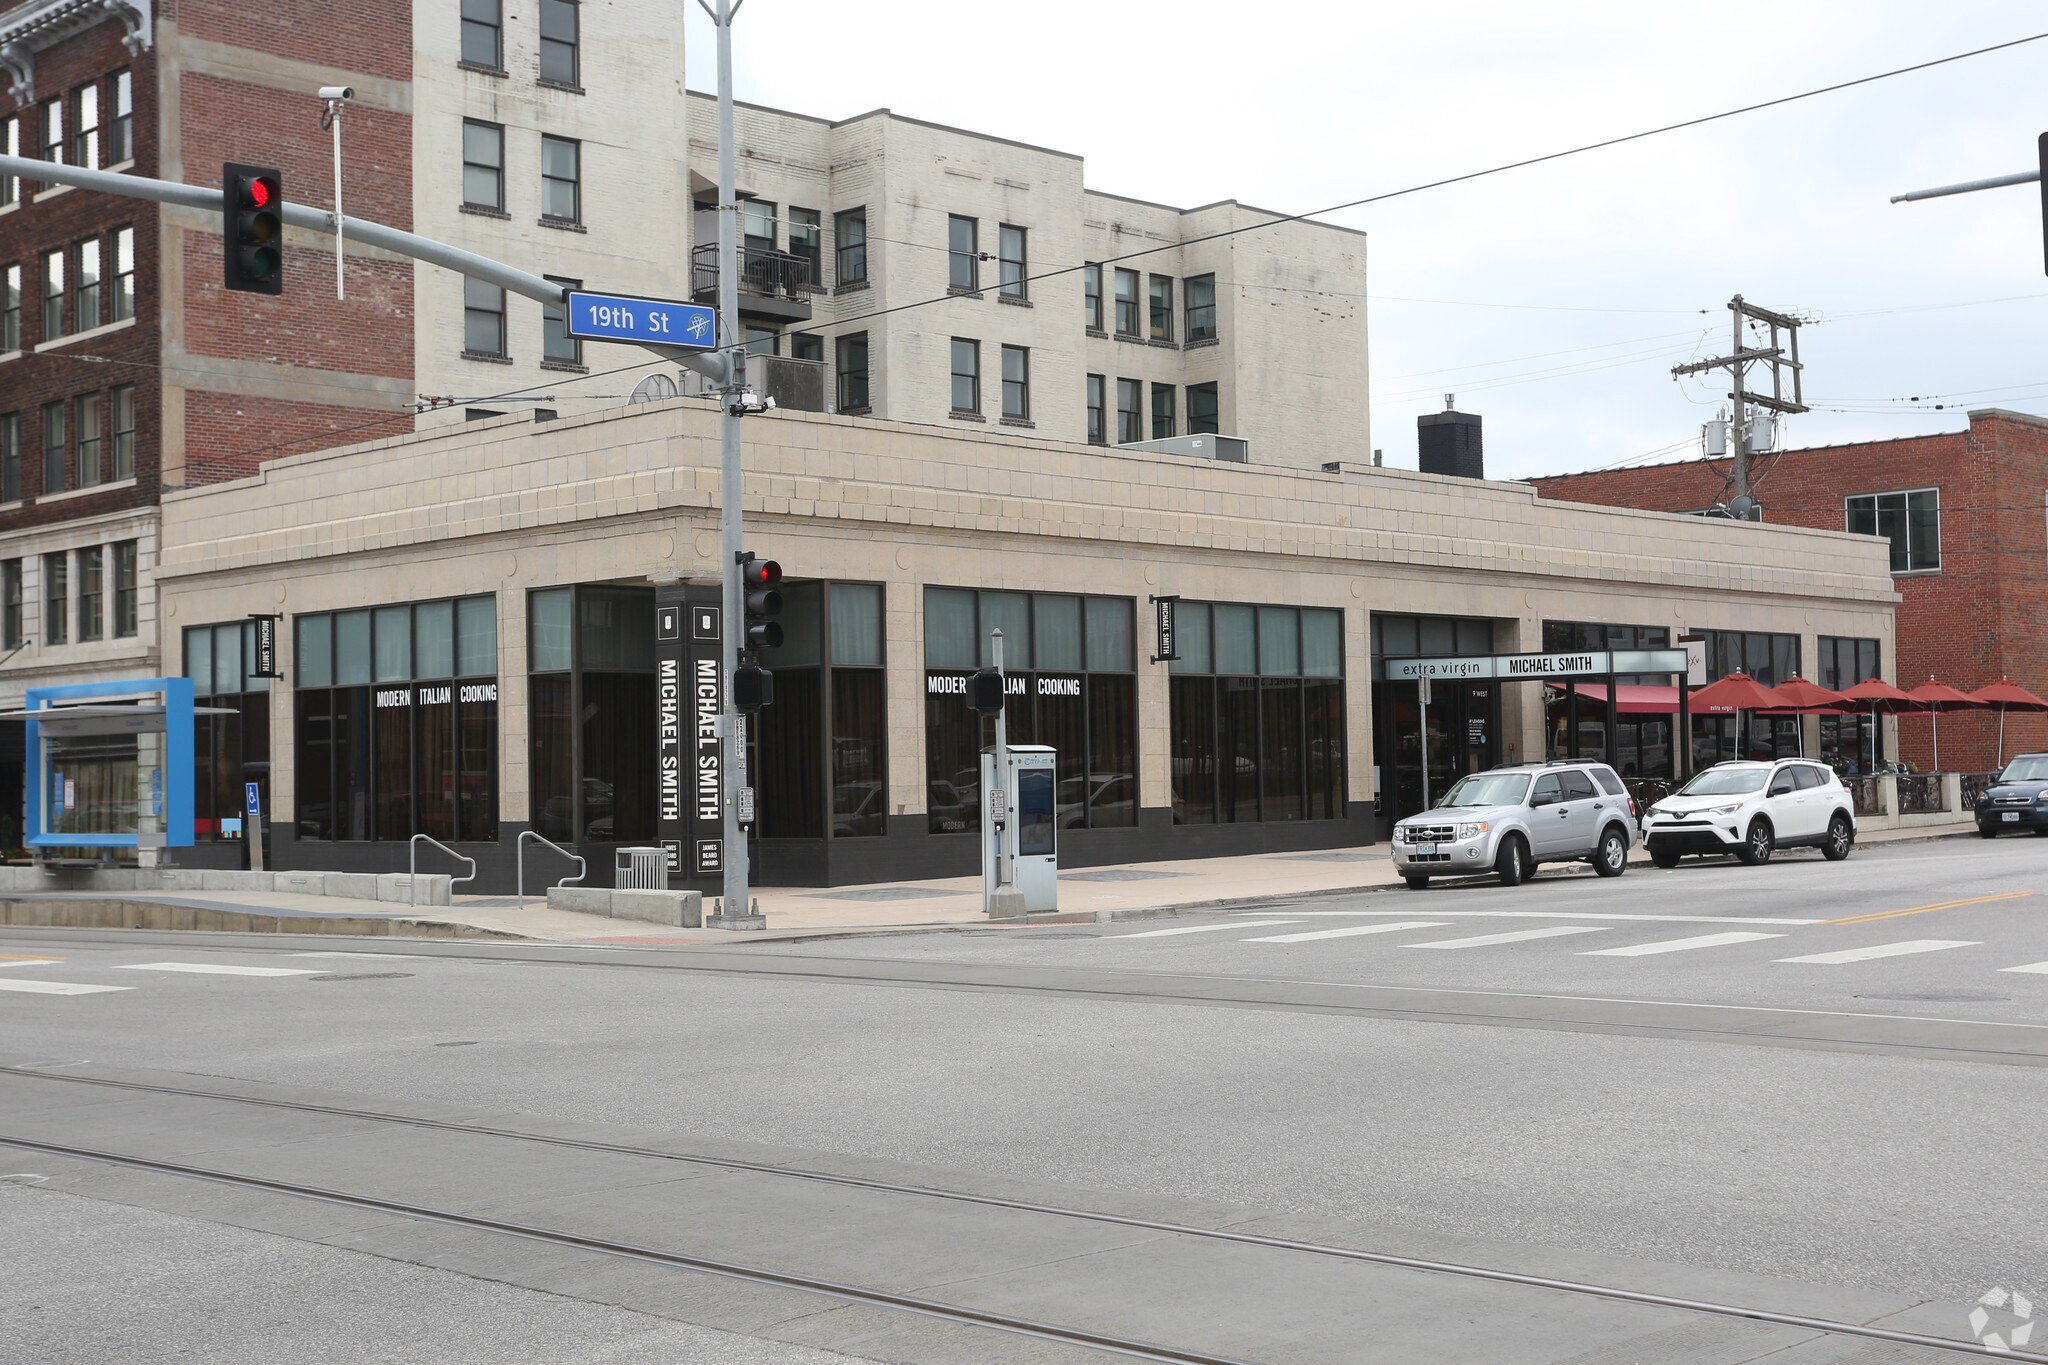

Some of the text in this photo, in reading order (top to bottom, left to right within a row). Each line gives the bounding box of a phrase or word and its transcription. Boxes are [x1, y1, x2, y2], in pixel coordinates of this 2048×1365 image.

[589, 305, 670, 333] 19th St
[262, 620, 270, 672] MICHAEL SMITH
[1403, 662, 1480, 677] extra virgin
[1509, 656, 1592, 674] MICHAEL SMITH
[376, 684, 497, 708] MODERN ITALIAN COOKING
[928, 676, 1080, 696] MODER LIAN COOKING
[661, 660, 678, 820] MICHAEL SMITH
[698, 660, 719, 820] MICHAEL SMITH
